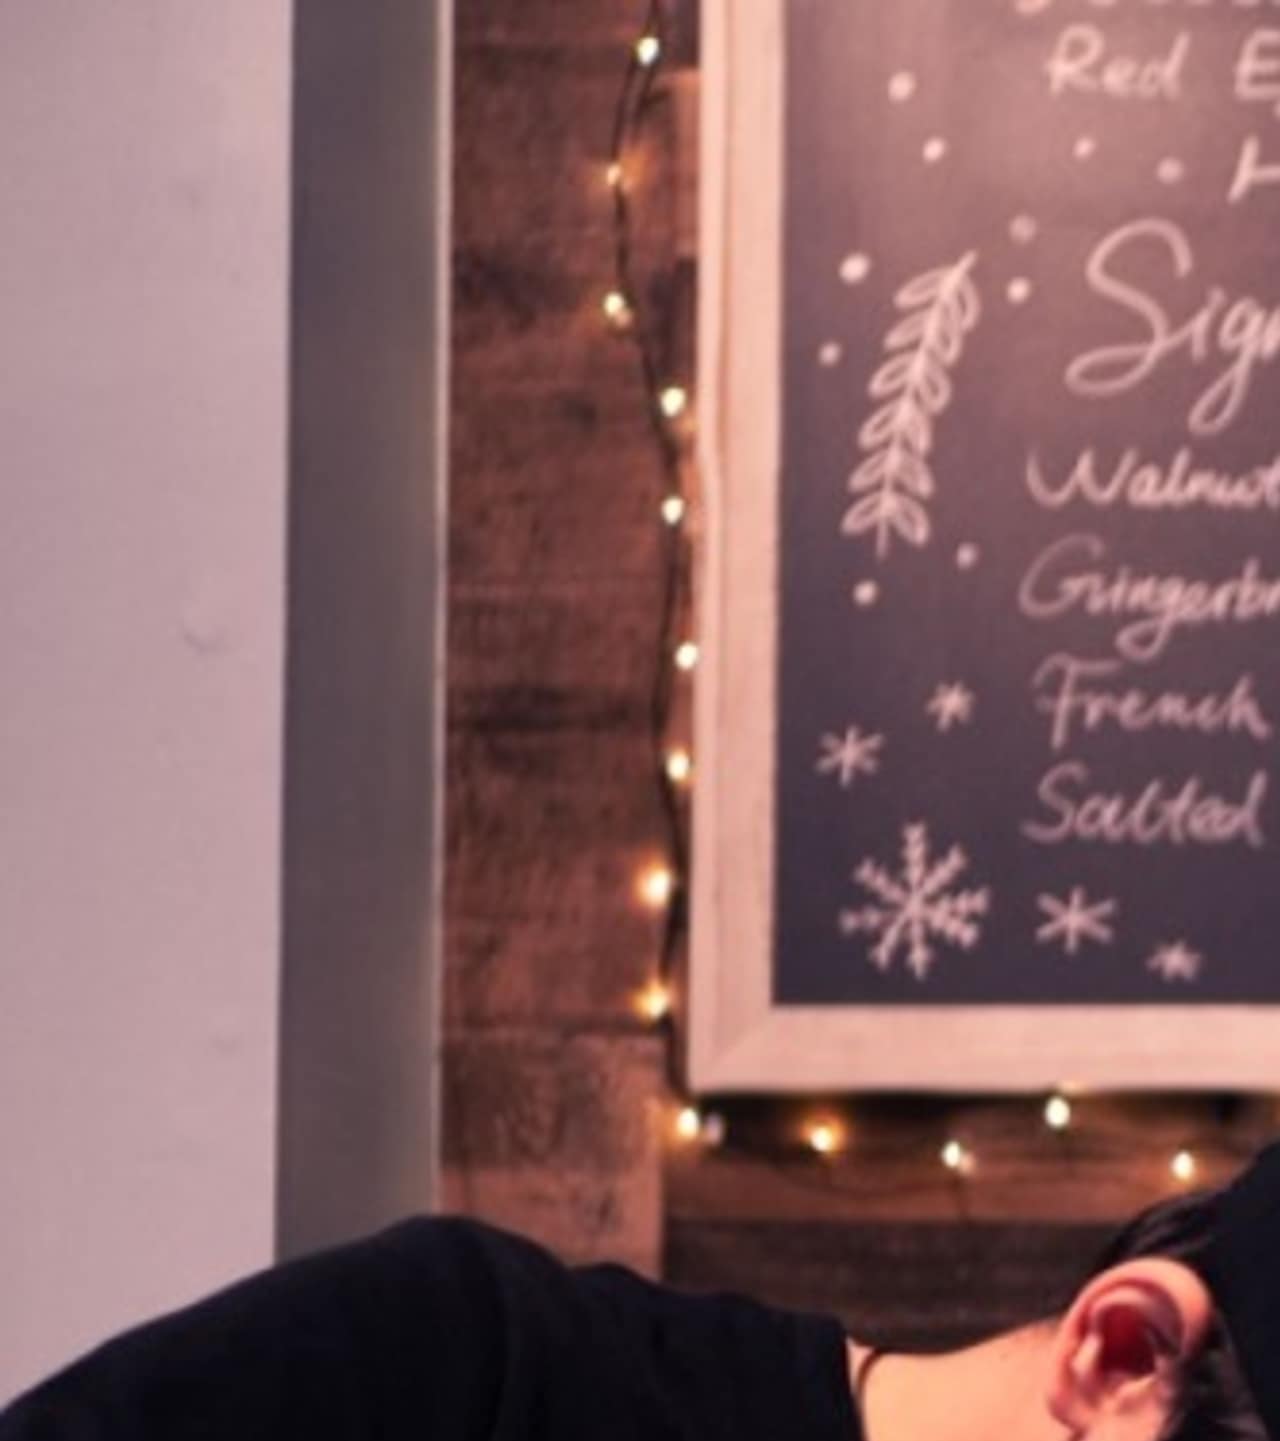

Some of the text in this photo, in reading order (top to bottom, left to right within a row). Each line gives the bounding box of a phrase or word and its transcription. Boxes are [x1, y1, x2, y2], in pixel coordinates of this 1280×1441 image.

[1044, 22, 1190, 99] Red
[1032, 654, 1270, 750] French
[1022, 763, 1268, 847] Salted
